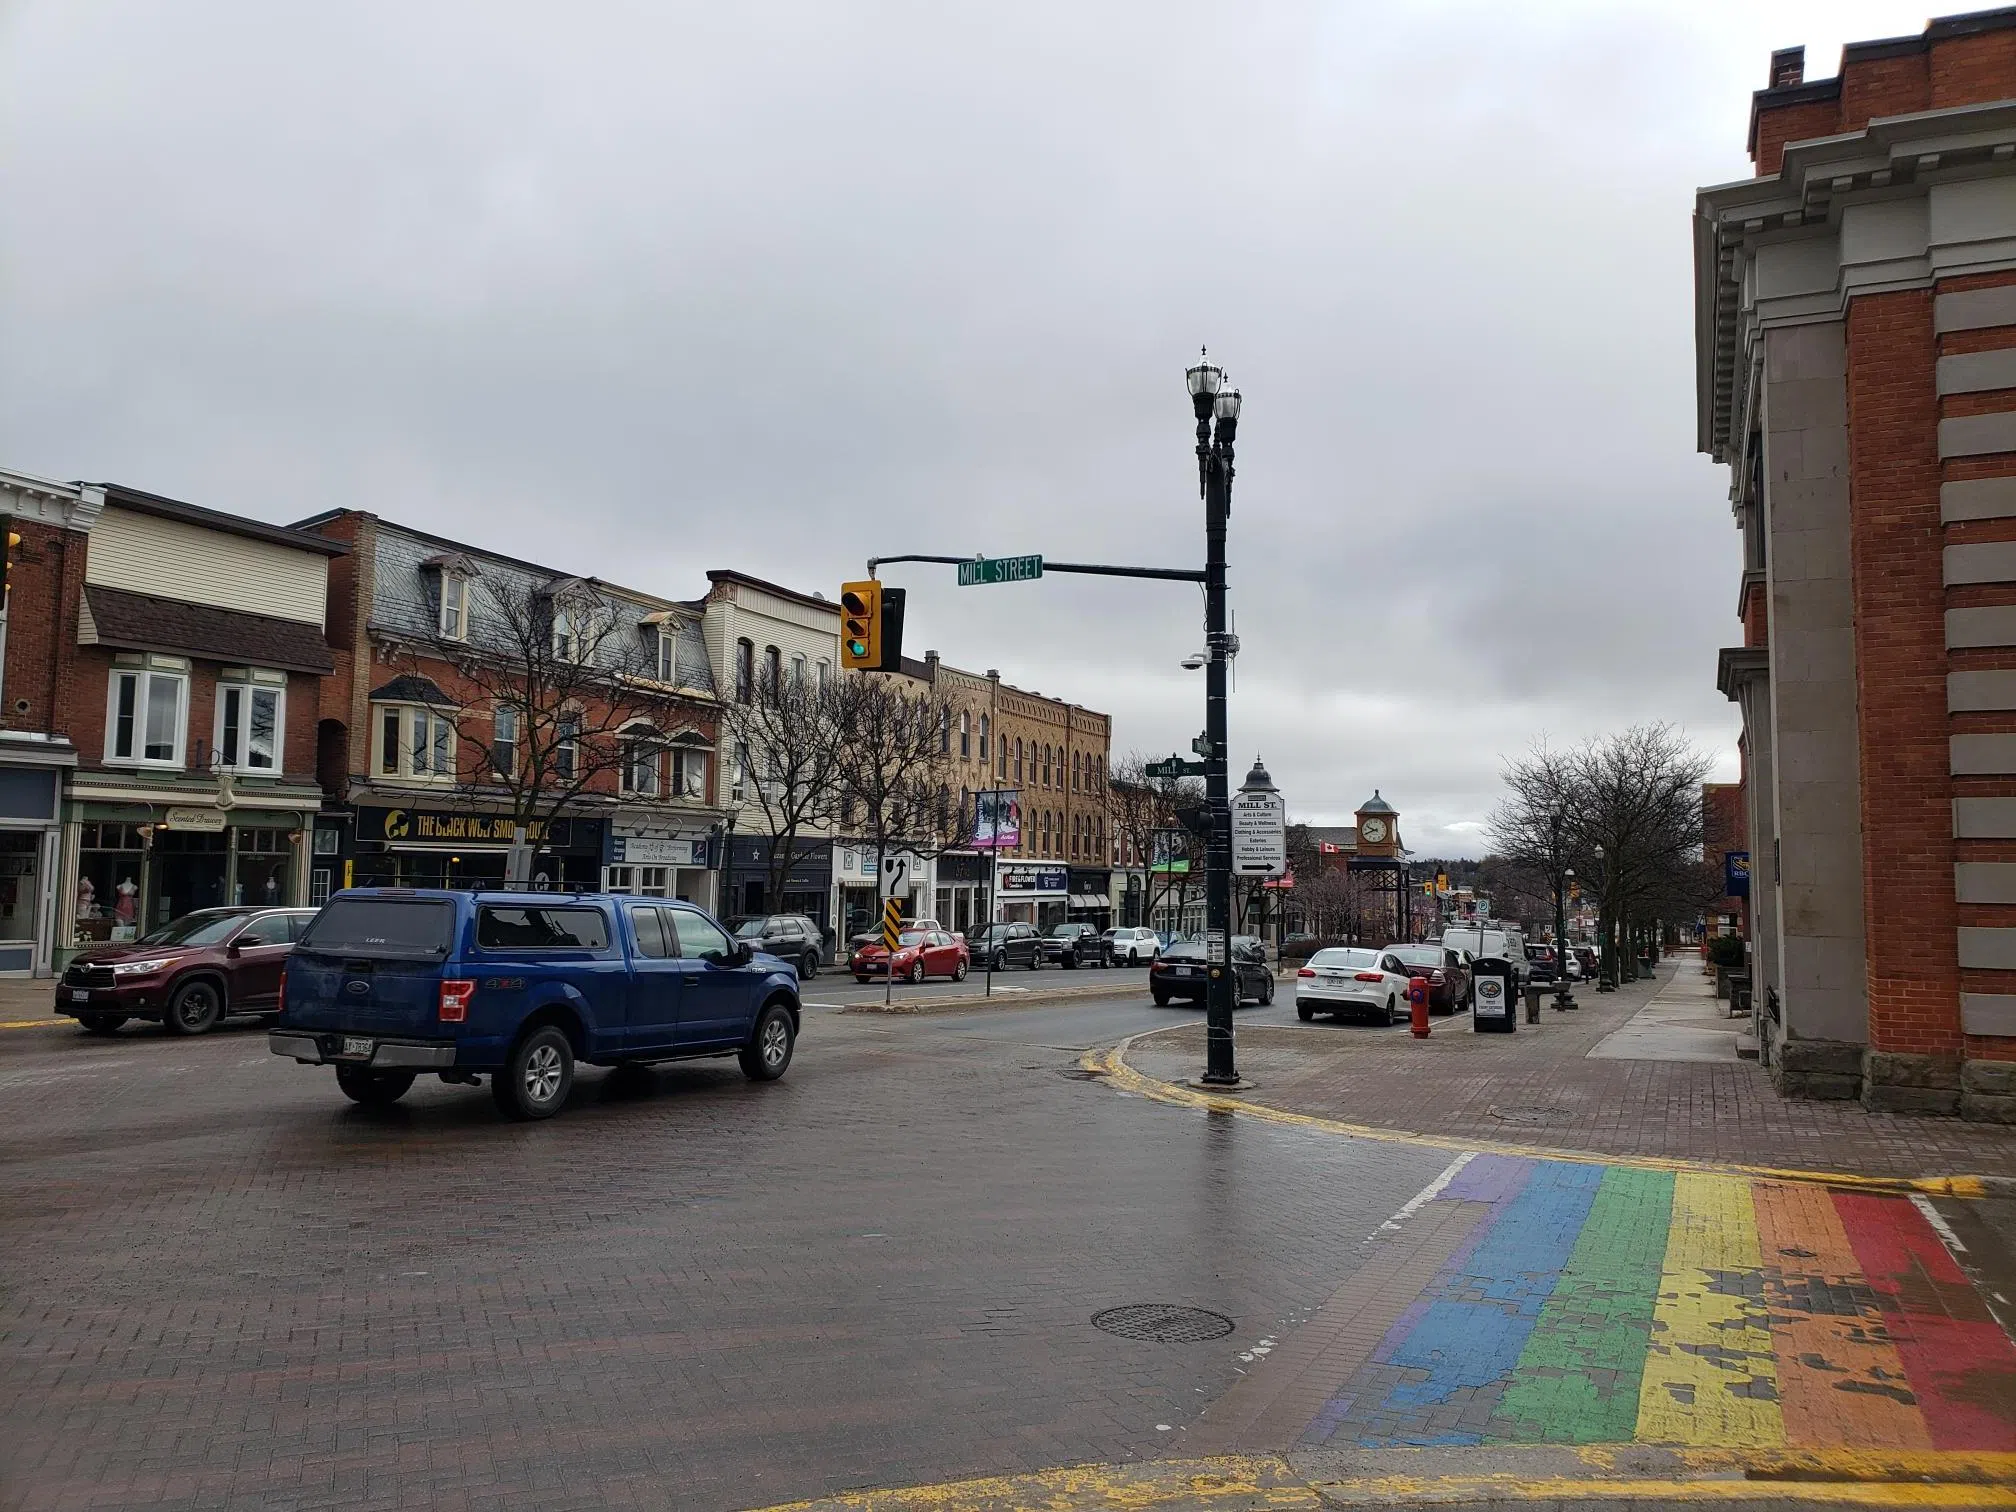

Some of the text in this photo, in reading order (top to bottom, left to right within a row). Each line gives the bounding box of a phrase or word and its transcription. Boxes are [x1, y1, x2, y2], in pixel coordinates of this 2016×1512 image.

[960, 556, 1040, 585] MILL STREET
[169, 811, 195, 823] Scented
[417, 816, 434, 836] THE
